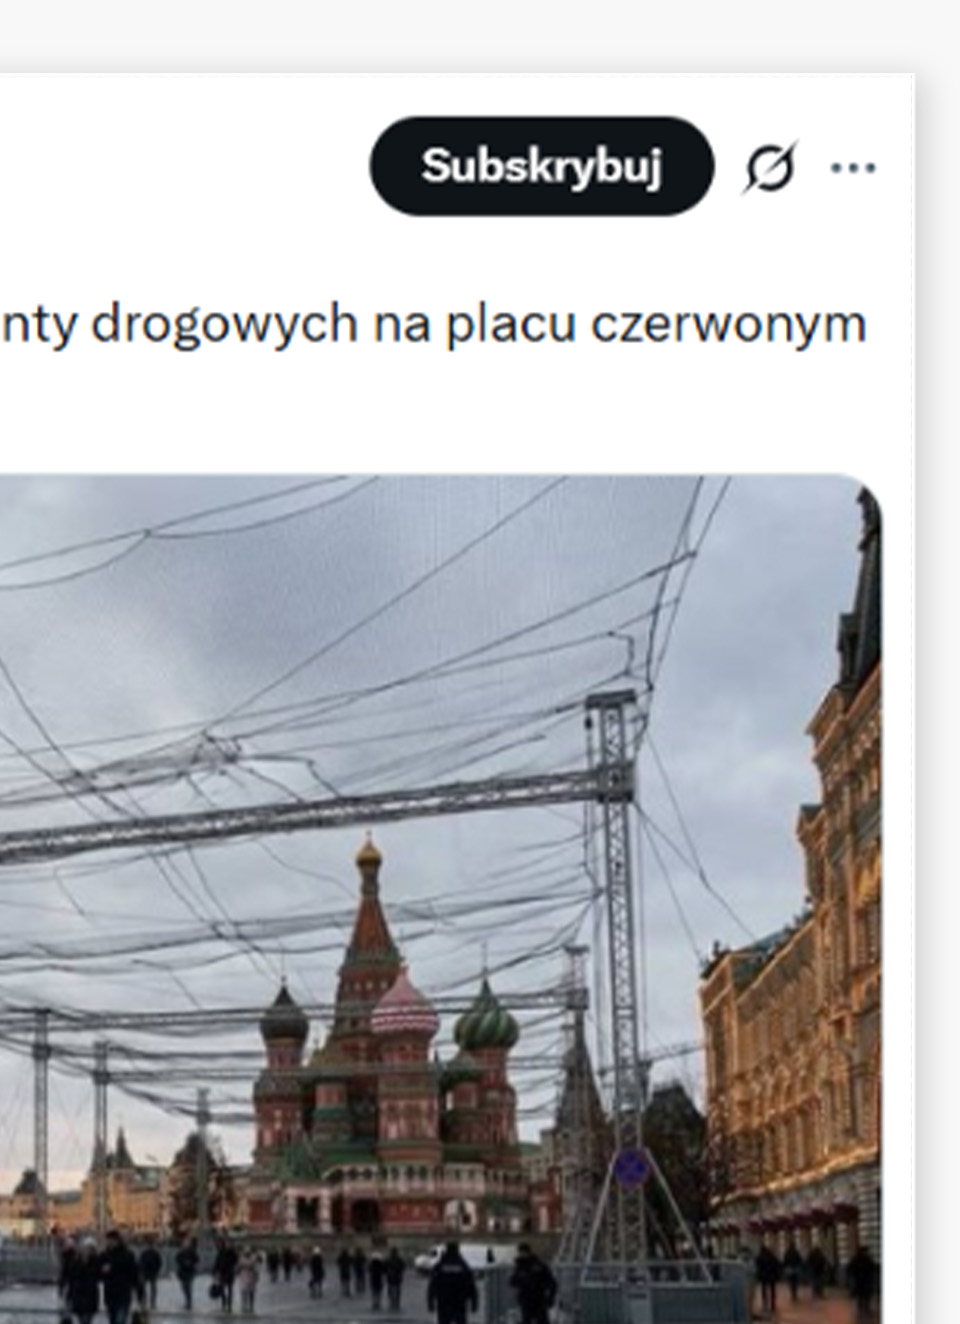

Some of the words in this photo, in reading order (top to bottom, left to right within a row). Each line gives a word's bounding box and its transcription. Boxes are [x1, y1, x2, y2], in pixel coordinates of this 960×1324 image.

[420, 143, 663, 194] Subskrybuj
[89, 299, 359, 353] drogowych
[373, 311, 432, 344] na
[445, 299, 577, 353] placu
[590, 311, 867, 353] czerwonym
